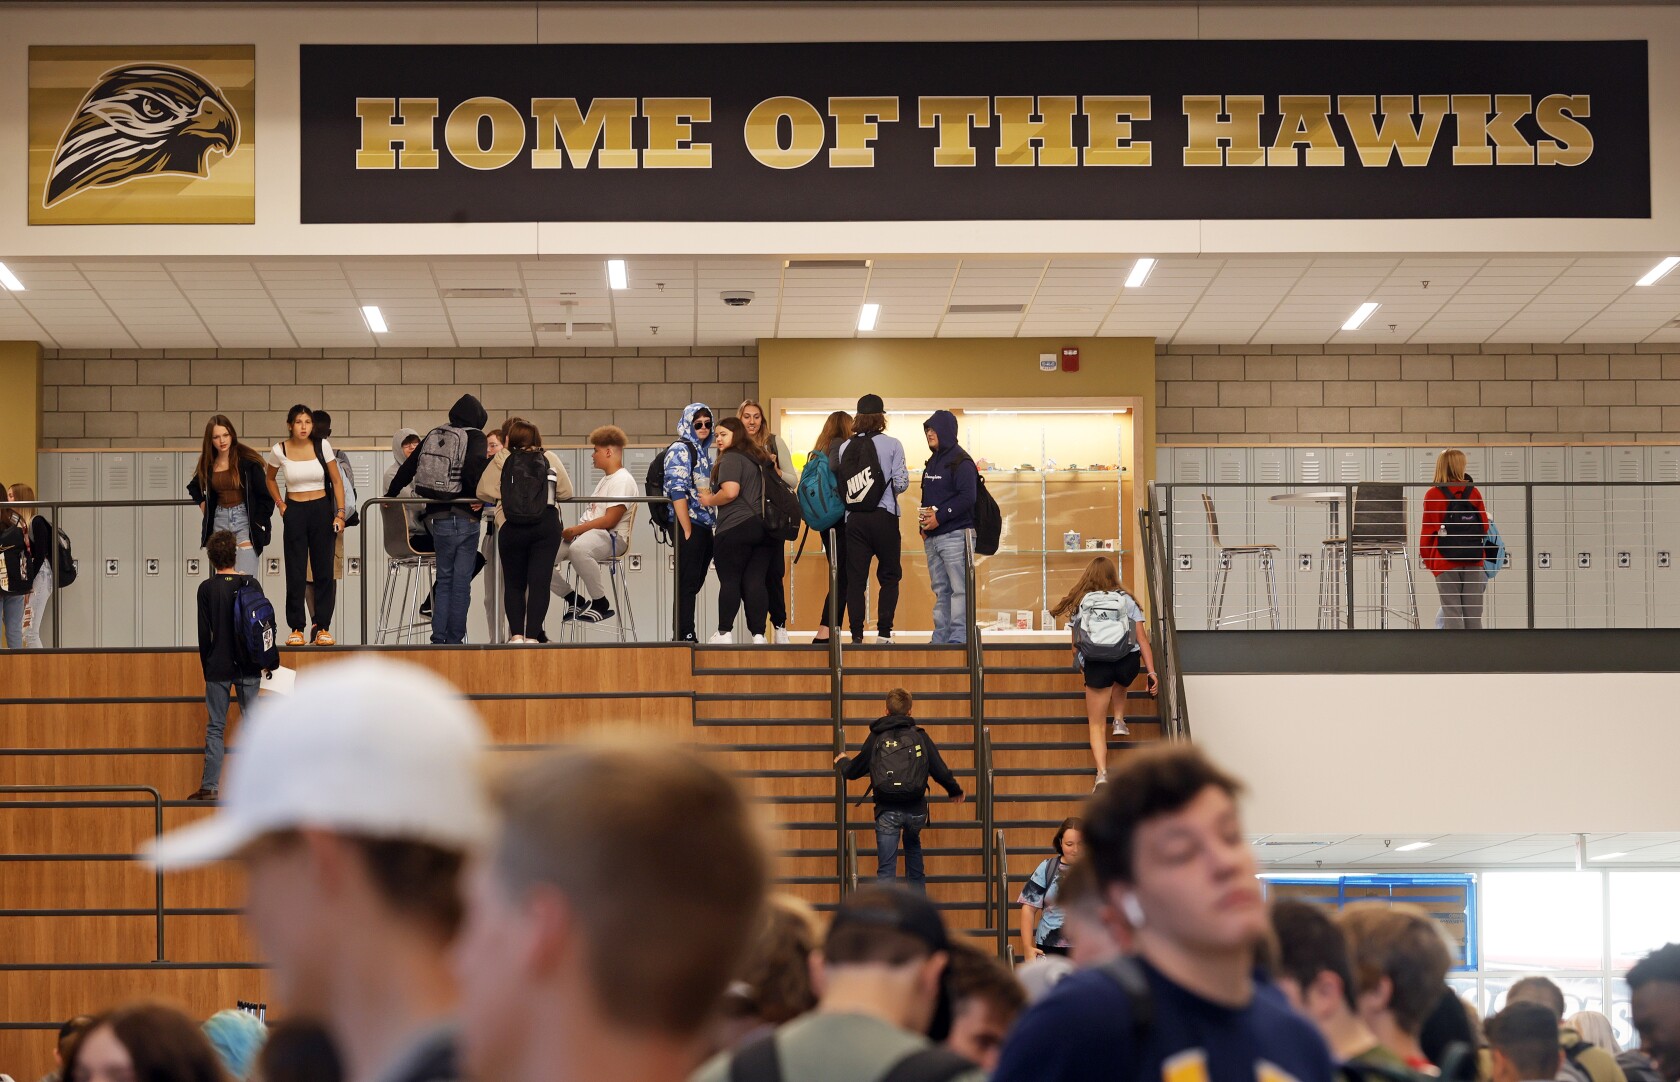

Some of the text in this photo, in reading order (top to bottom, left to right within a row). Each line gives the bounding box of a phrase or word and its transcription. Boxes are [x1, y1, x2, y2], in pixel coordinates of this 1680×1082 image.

[355, 93, 1594, 170] HOME OF THE HAWKS
[847, 466, 872, 496] NIKE
